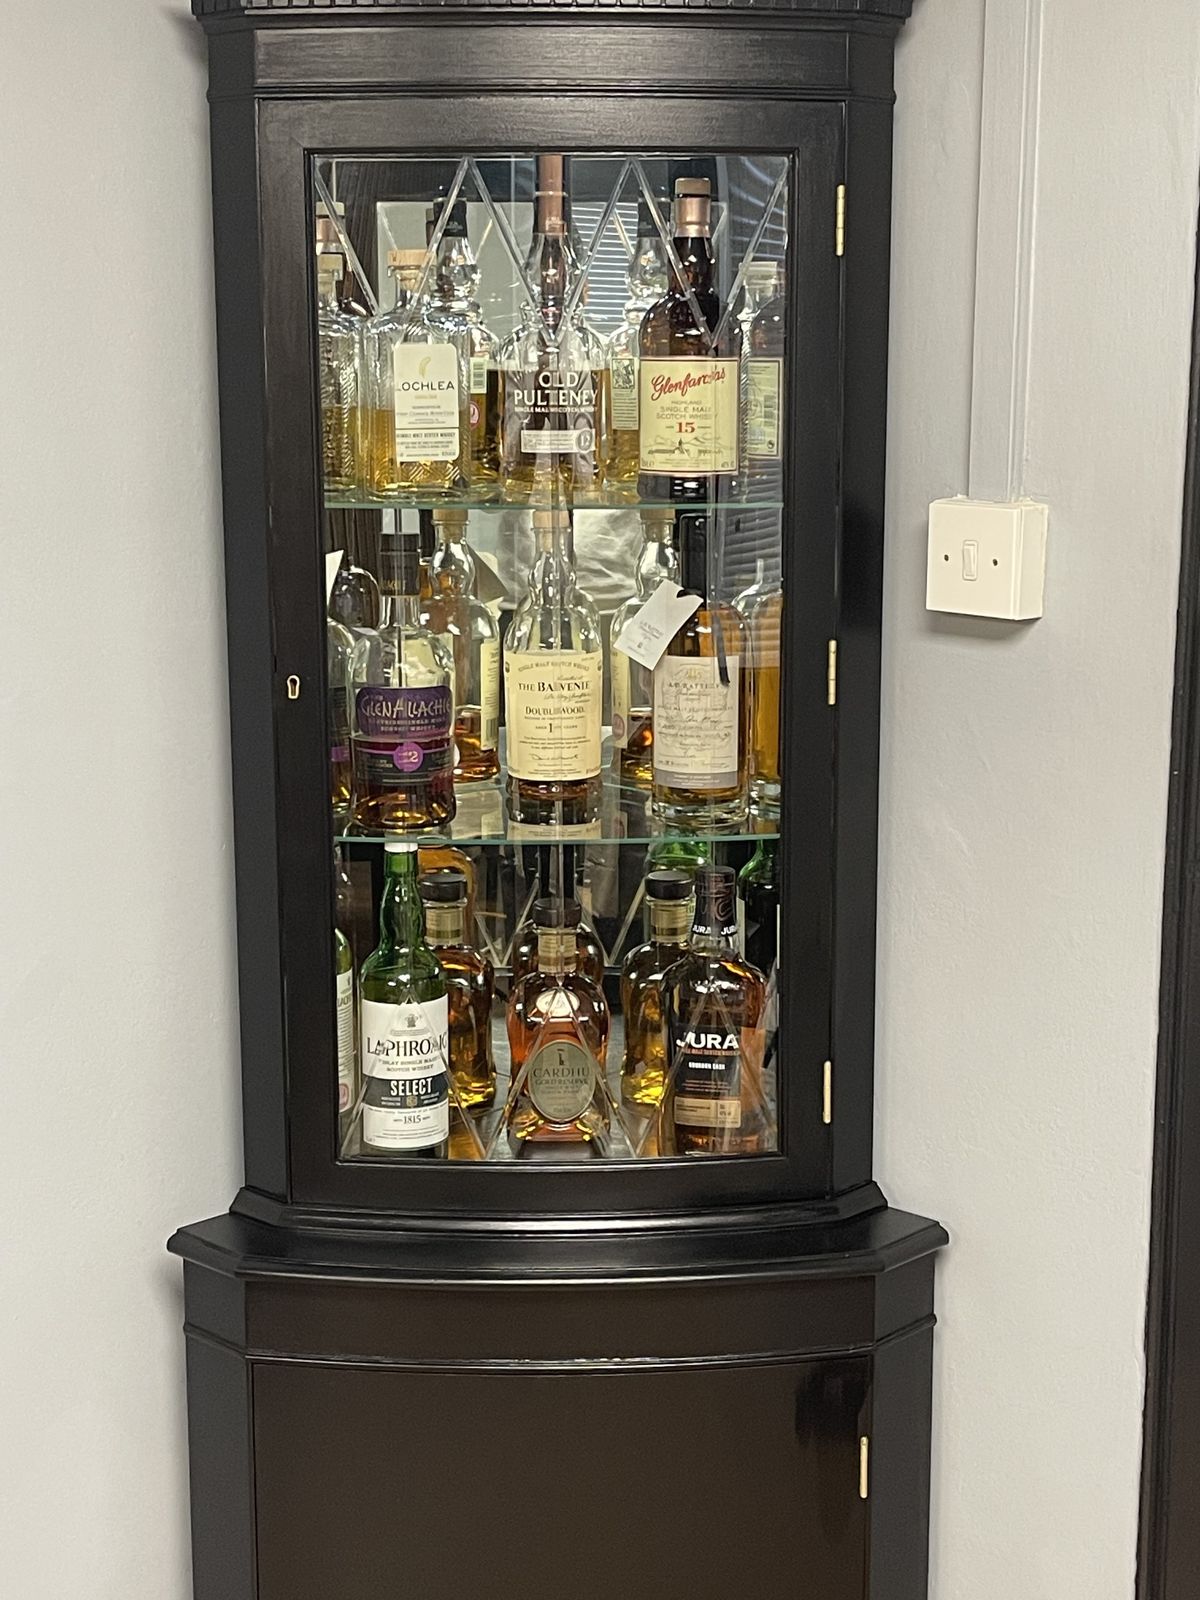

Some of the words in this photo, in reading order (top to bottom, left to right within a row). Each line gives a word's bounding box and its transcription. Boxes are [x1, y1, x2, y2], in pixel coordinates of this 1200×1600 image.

[539, 371, 579, 388] OLD
[514, 389, 598, 406] PULTENEY
[676, 422, 695, 434] 15
[518, 682, 536, 692] THE
[537, 681, 591, 692] BAVENIE
[676, 1031, 739, 1050] JURA
[533, 1067, 590, 1078] CARDHU
[390, 1077, 433, 1097] SELECT
[403, 1113, 422, 1125] 1815
